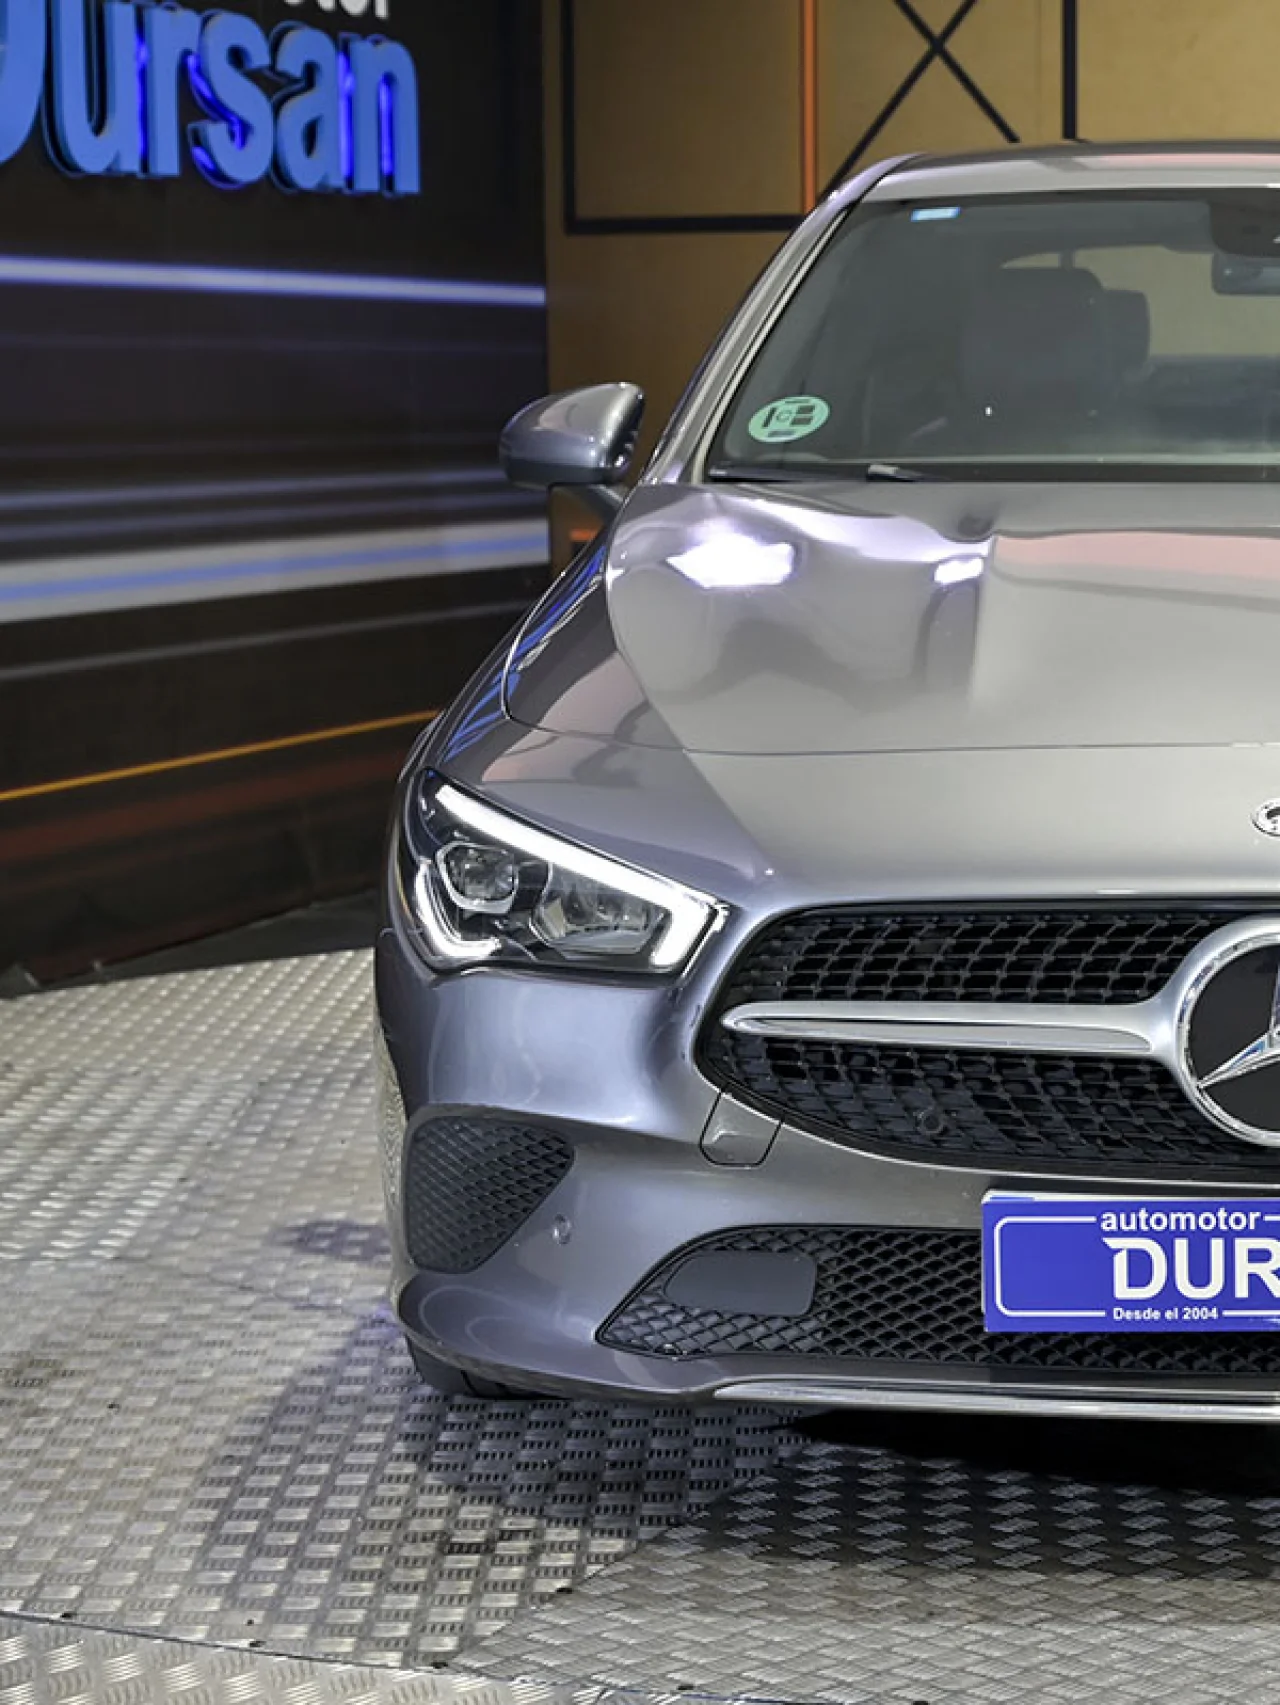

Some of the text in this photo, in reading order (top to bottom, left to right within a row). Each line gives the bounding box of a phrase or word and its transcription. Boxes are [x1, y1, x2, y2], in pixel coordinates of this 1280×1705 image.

[1100, 1207, 1262, 1232] automotor
[1112, 1306, 1219, 1321] Desde el 2004
